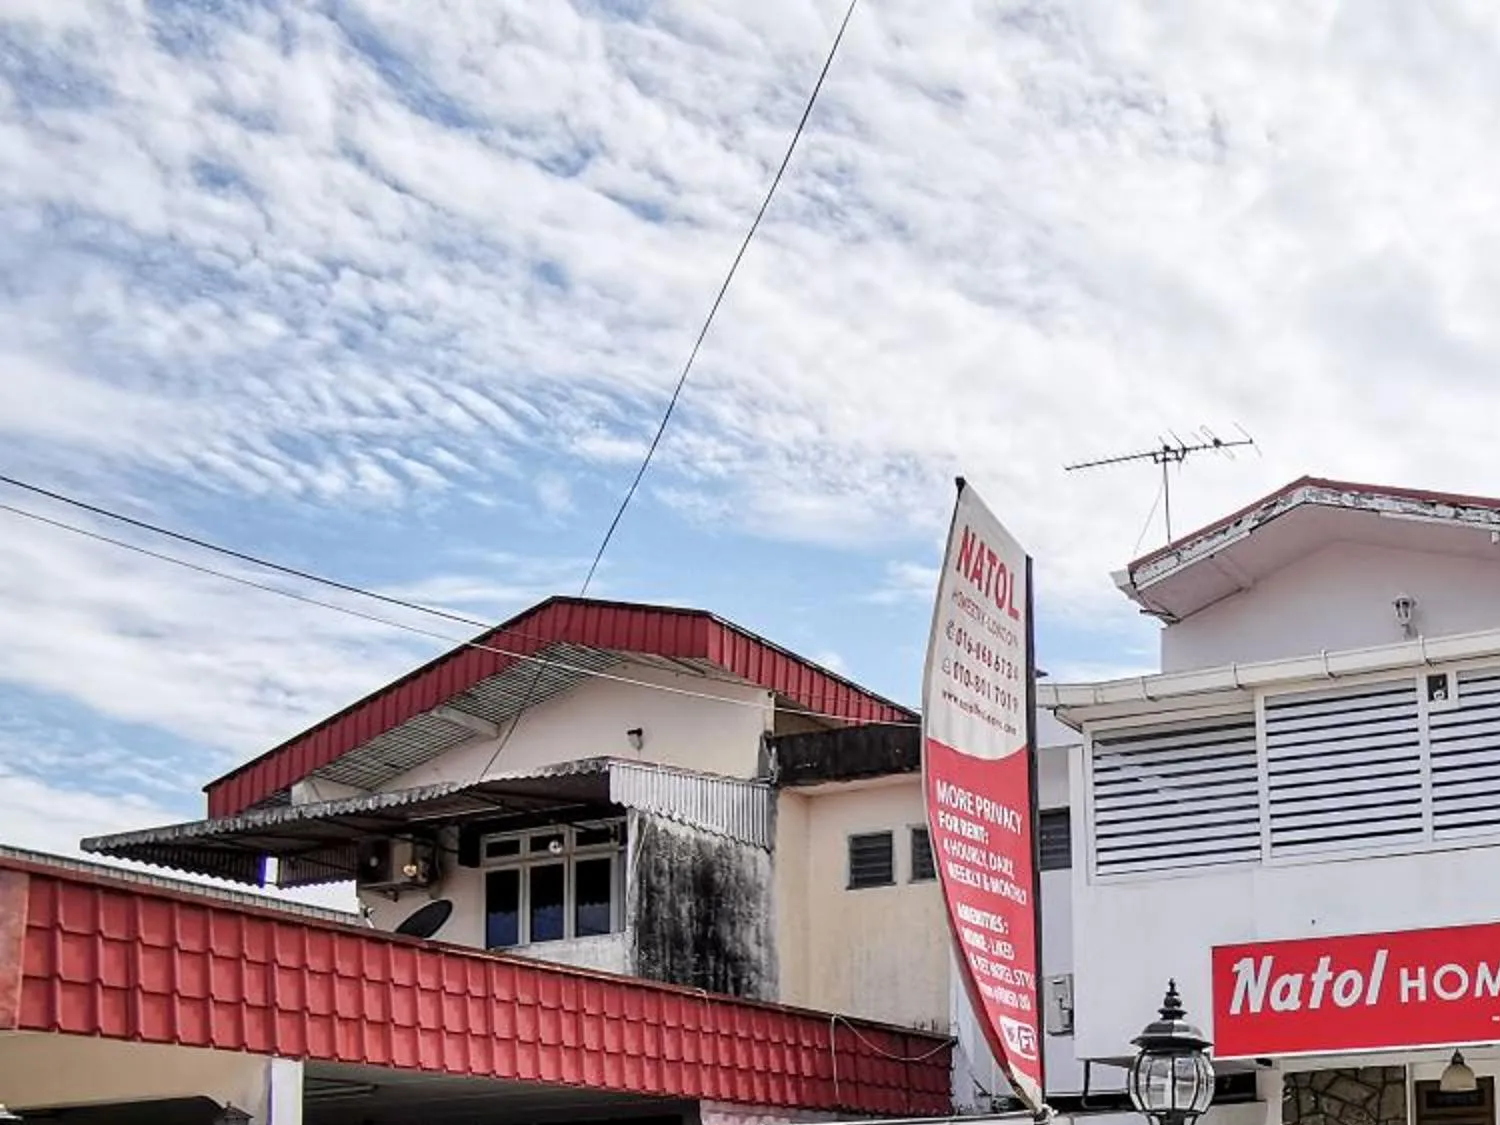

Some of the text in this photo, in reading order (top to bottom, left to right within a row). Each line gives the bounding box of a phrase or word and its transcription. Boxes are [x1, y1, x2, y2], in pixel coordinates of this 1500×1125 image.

[956, 525, 1019, 622] NATOL
[936, 779, 1022, 836] MORE PRIVACY
[938, 810, 960, 835] FOR
[1230, 949, 1388, 1016] Natol
